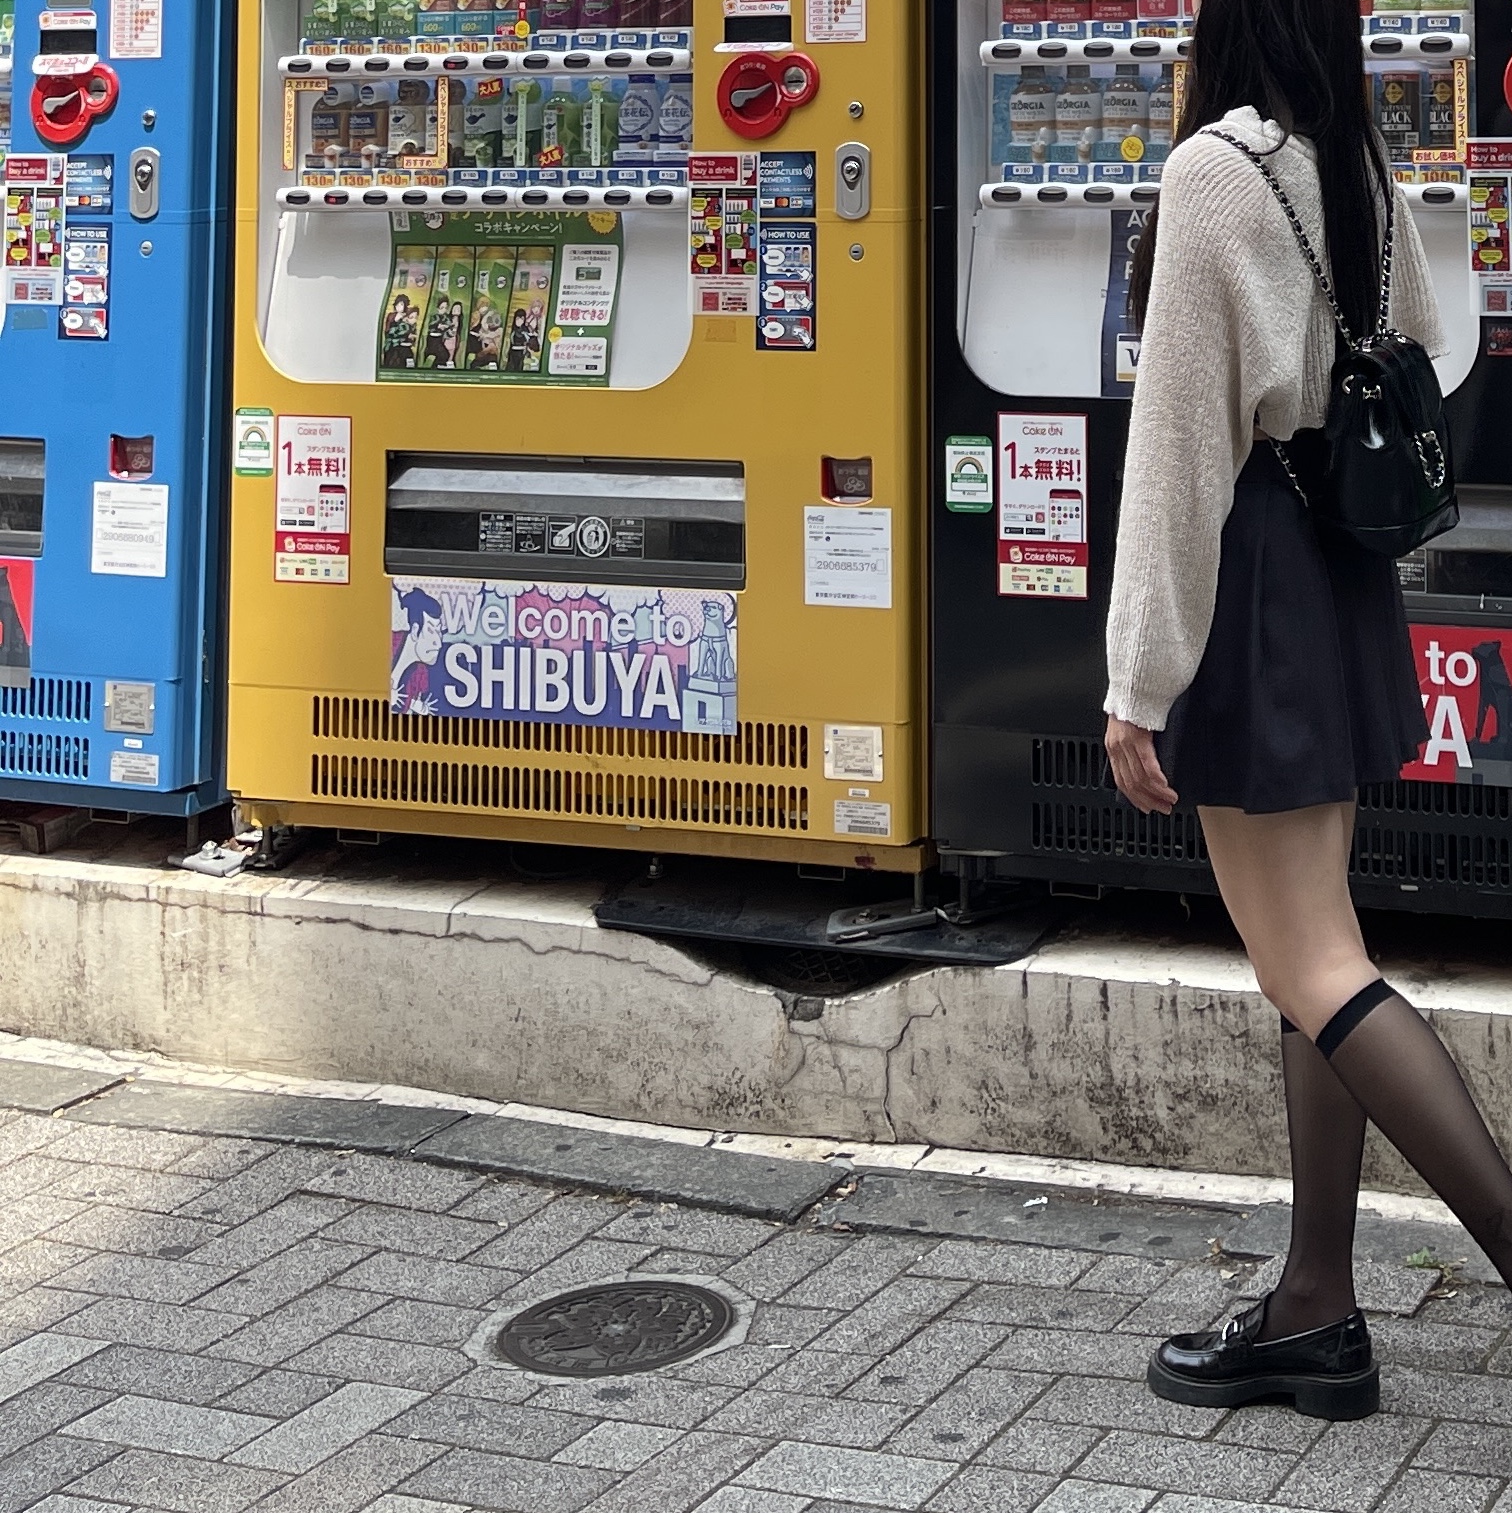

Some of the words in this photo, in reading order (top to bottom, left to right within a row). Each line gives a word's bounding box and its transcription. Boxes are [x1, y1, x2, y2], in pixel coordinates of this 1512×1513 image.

[1415, 152, 1457, 161] お試し価格
[760, 161, 784, 169] ACCEPT
[1422, 172, 1459, 183] 100円
[474, 222, 563, 234] コラボキャンペーン!
[768, 231, 787, 239] HOW
[788, 231, 797, 239] TO
[797, 231, 810, 239] USE
[559, 307, 608, 321] 視聴できる!
[1023, 426, 1047, 436] Coke
[1048, 426, 1063, 436] ON
[1034, 446, 1080, 455] スタンプたまると
[282, 440, 347, 479] 1本無料!
[1004, 441, 1081, 482] 1本無料!
[1059, 553, 1076, 565] Pay
[442, 592, 636, 643] Welcome
[650, 607, 692, 647] to
[1425, 641, 1477, 687] to
[444, 643, 681, 720] SHIBUYA
